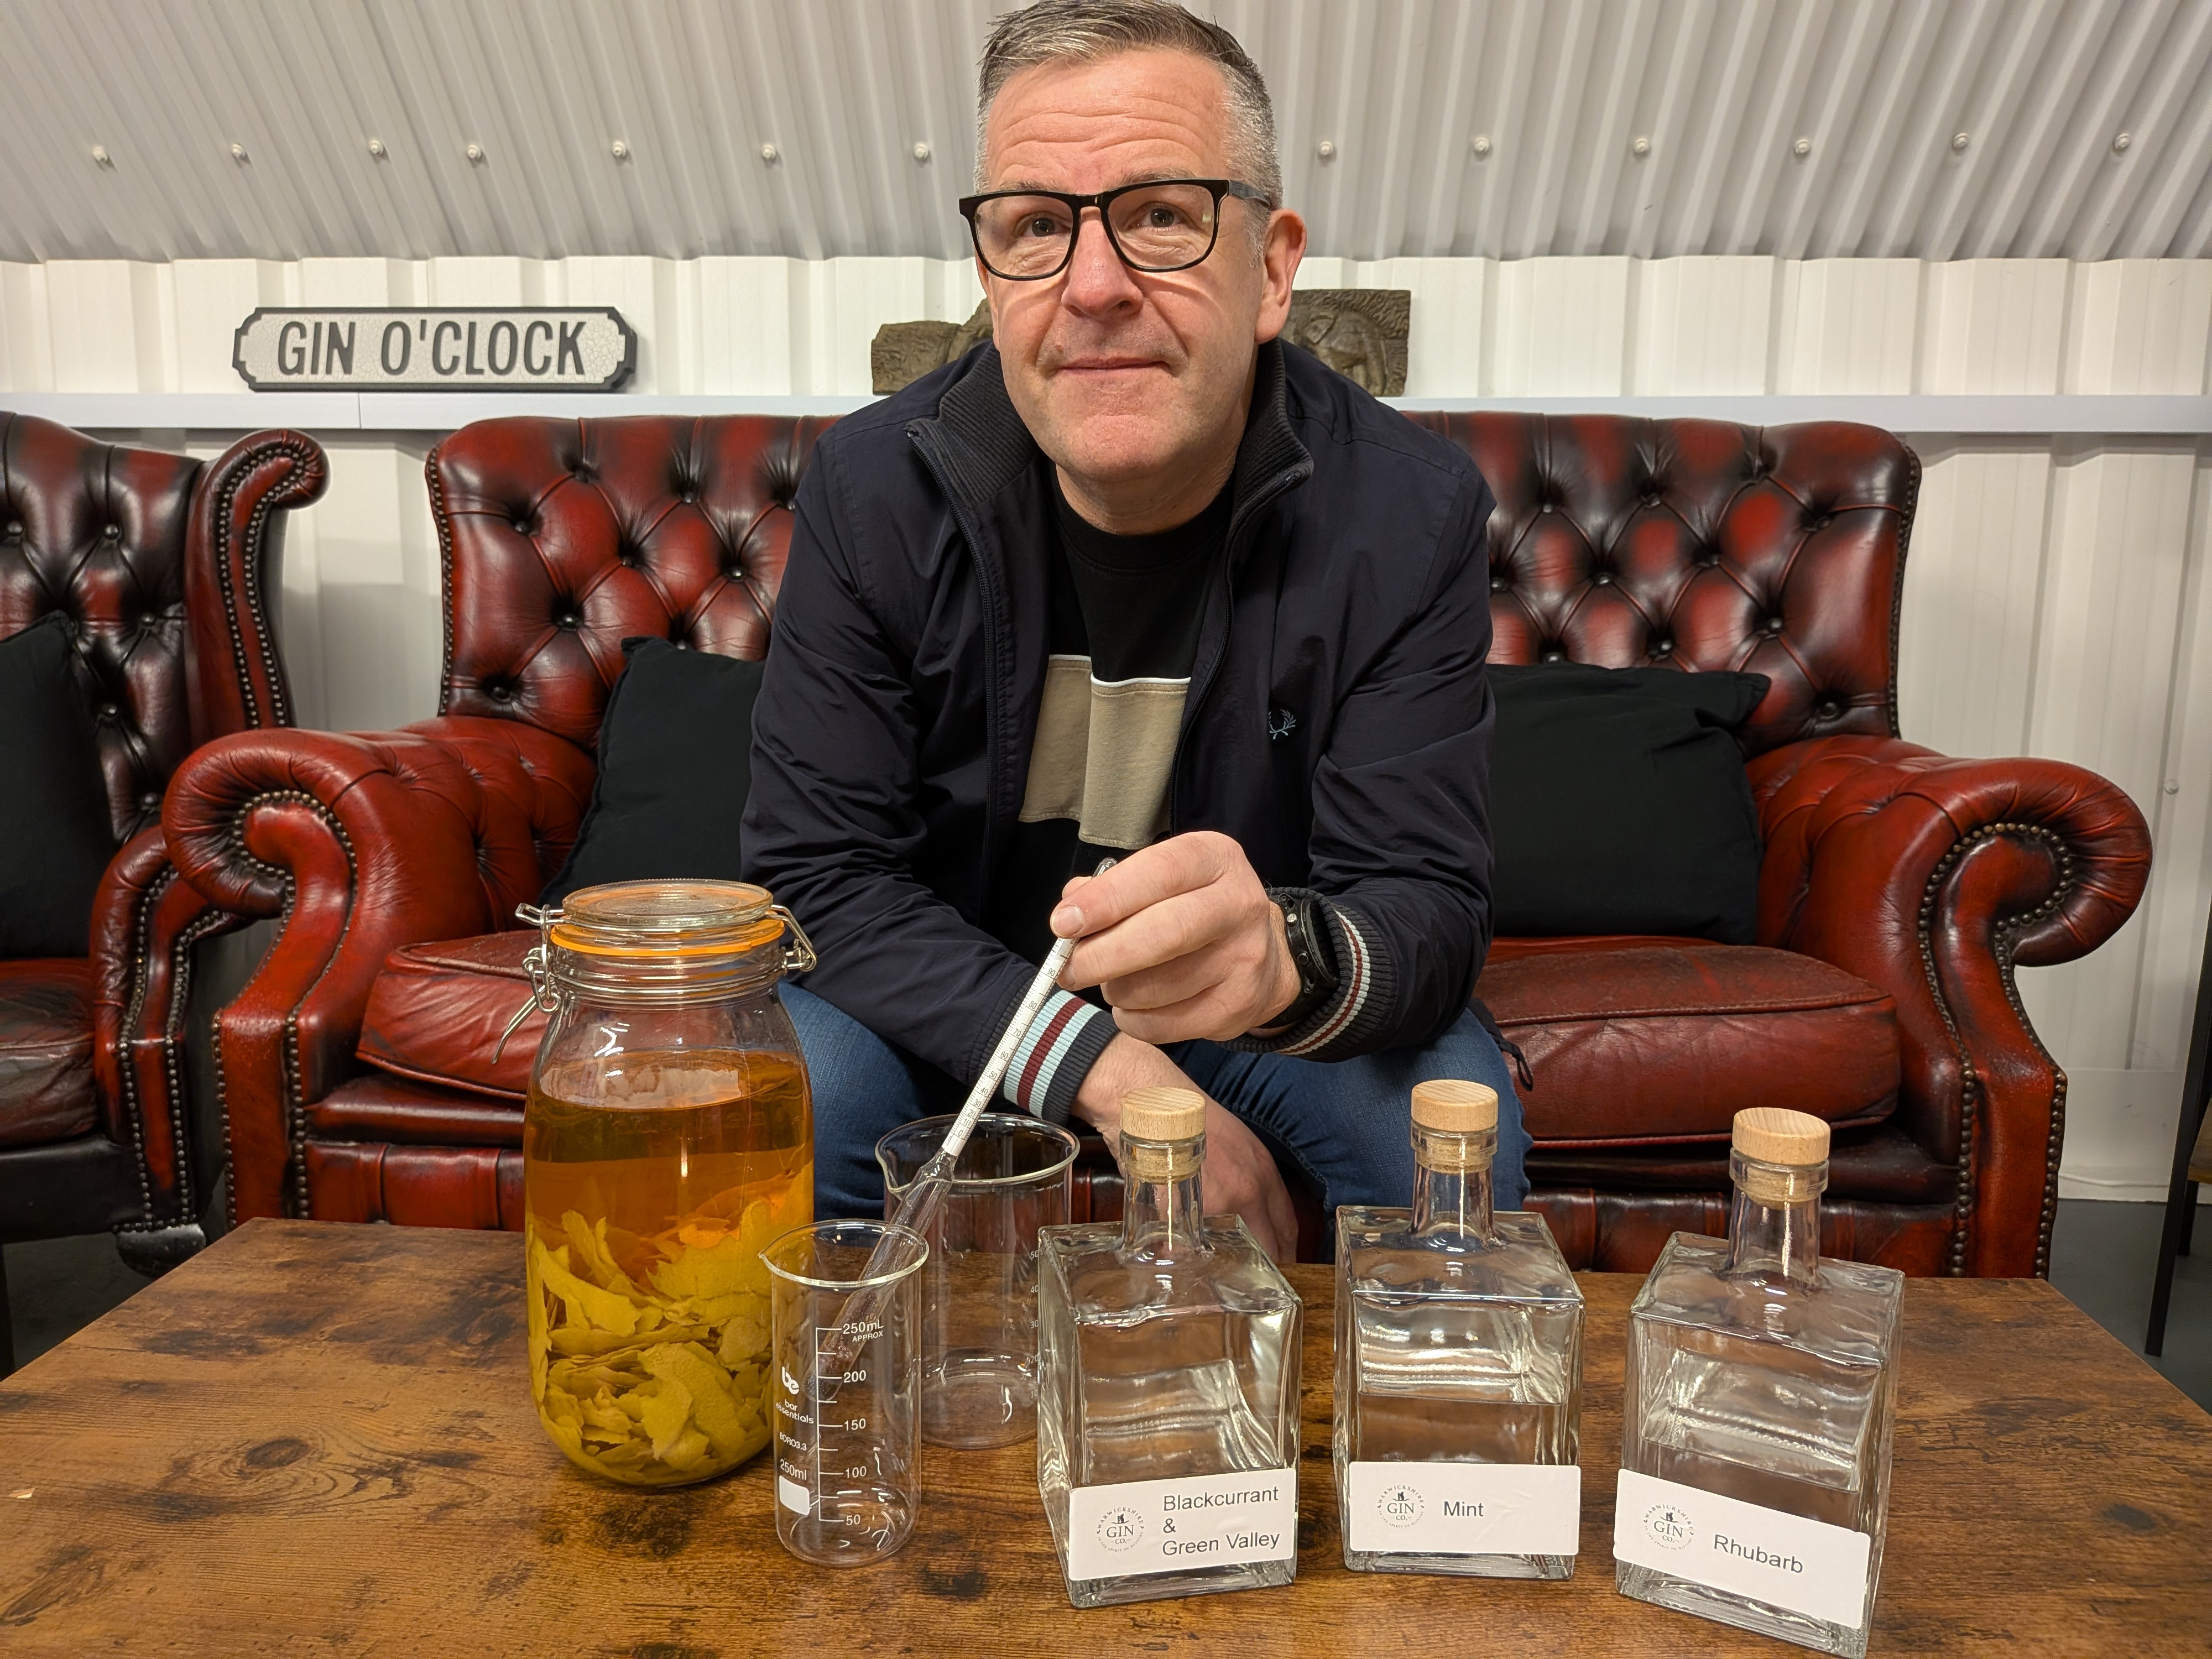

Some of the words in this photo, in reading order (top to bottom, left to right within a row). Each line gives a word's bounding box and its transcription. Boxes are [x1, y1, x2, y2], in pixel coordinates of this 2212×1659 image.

[278, 321, 356, 375] GIN
[381, 319, 587, 376] O'CLOCK
[1047, 968, 1056, 977] 90
[1029, 1001, 1037, 1009] 80
[1014, 1028, 1021, 1036] 70
[1000, 1051, 1009, 1060] 60
[989, 1071, 997, 1079] 50
[974, 1099, 982, 1108] 30
[968, 1109, 975, 1117] 20
[843, 1319, 884, 1334] 250mL
[852, 1330, 883, 1343] APPROX
[843, 1370, 867, 1383] 200
[784, 1399, 798, 1411] bar
[776, 1402, 814, 1424] essentials
[844, 1418, 867, 1431] 150
[779, 1431, 807, 1451] BORO3.3
[780, 1458, 807, 1481] 250ml
[845, 1465, 867, 1479] 100
[1163, 1486, 1279, 1512] Blackcurrant
[1378, 1485, 1424, 1504] WARWICKSHIRE
[1387, 1503, 1415, 1514] GIN
[1443, 1501, 1484, 1517] Mint
[846, 1514, 861, 1526] 50
[1097, 1507, 1144, 1528] WARWICKSHIRE
[1645, 1504, 1694, 1530] WARWICKSHIRE
[1107, 1524, 1134, 1537] GIN
[1163, 1518, 1176, 1533] &
[1653, 1520, 1683, 1538] GIN
[1162, 1536, 1219, 1556] Green
[1225, 1532, 1280, 1551] Valley
[1662, 1535, 1674, 1543] CO.
[1714, 1533, 1803, 1574] Rhubarb
